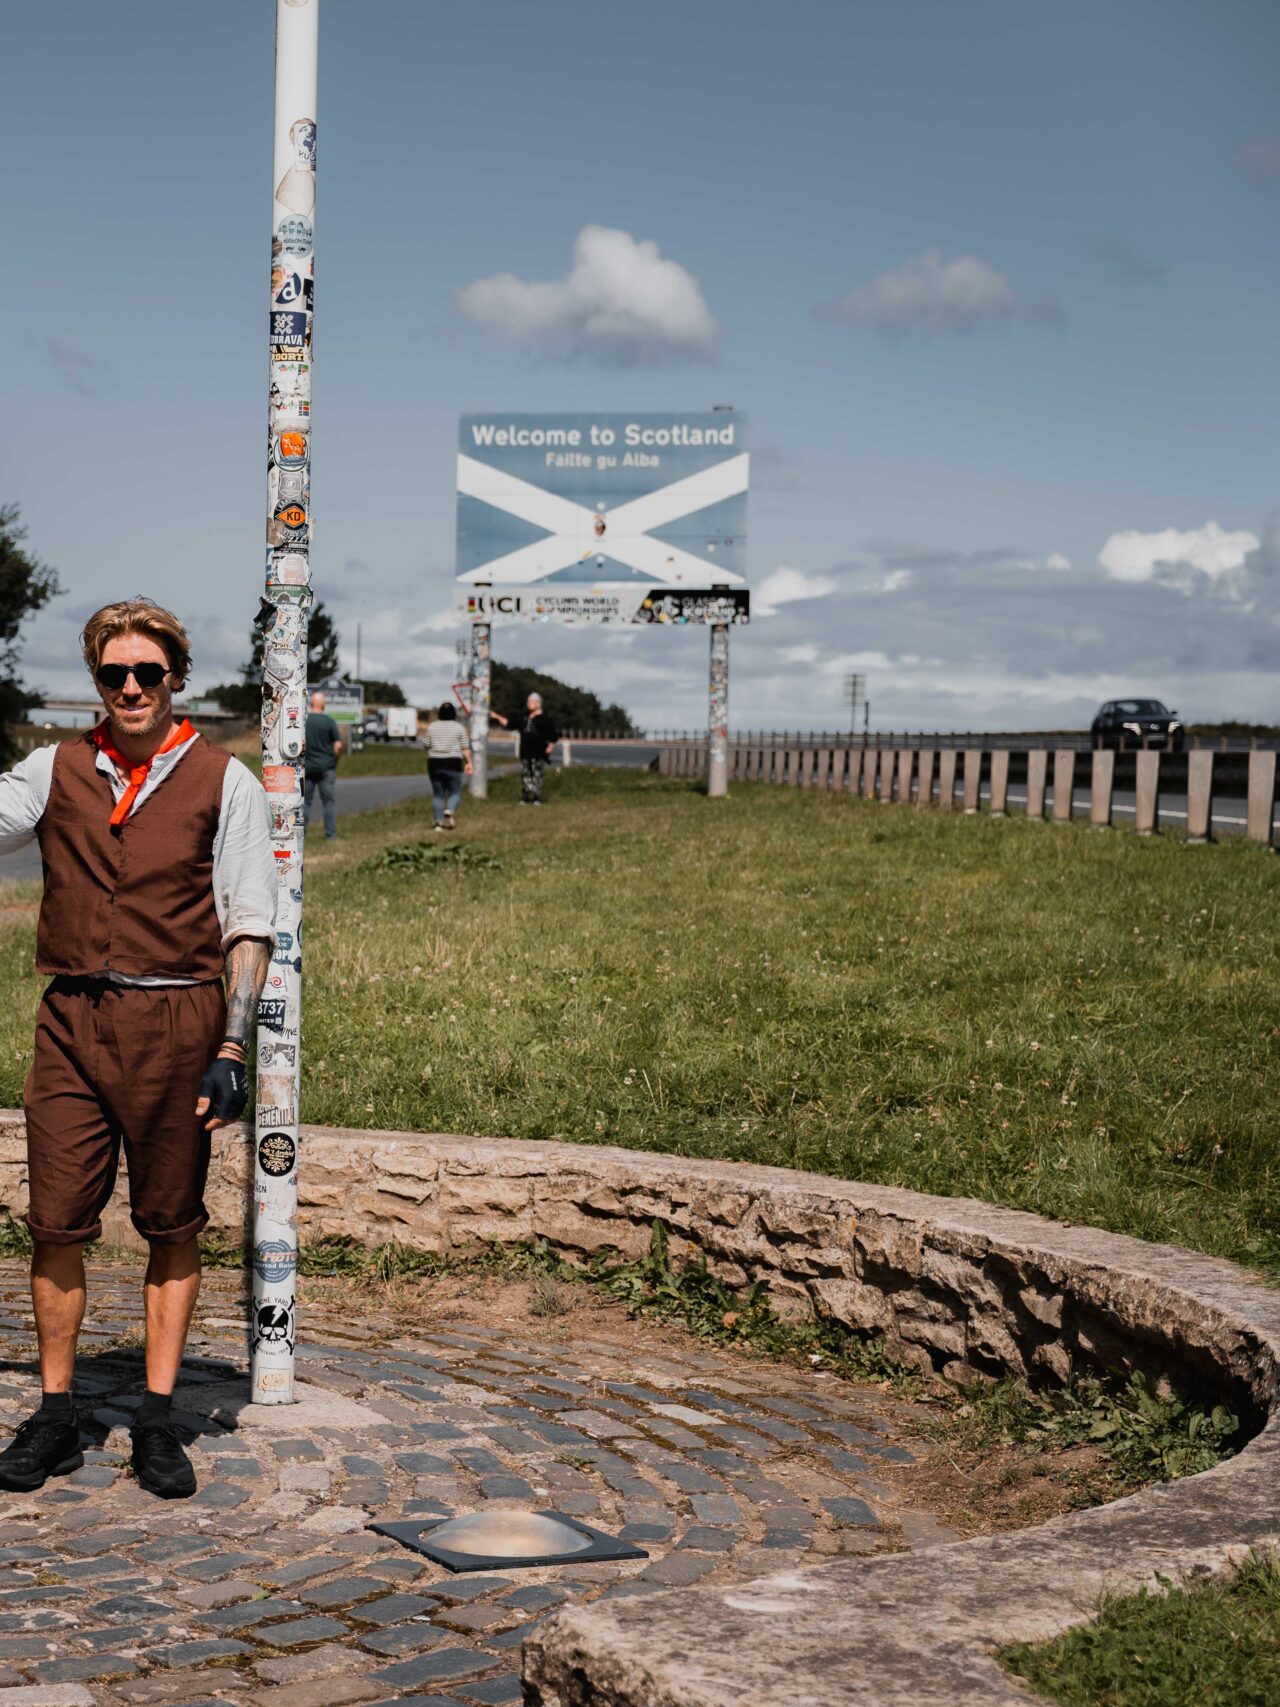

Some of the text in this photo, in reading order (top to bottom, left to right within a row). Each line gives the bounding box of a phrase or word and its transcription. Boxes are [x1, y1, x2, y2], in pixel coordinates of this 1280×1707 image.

[472, 423, 735, 446] Welcome to Scotland
[597, 455, 617, 470] gu
[622, 451, 660, 467] Alba
[274, 1297, 289, 1306] YARD
